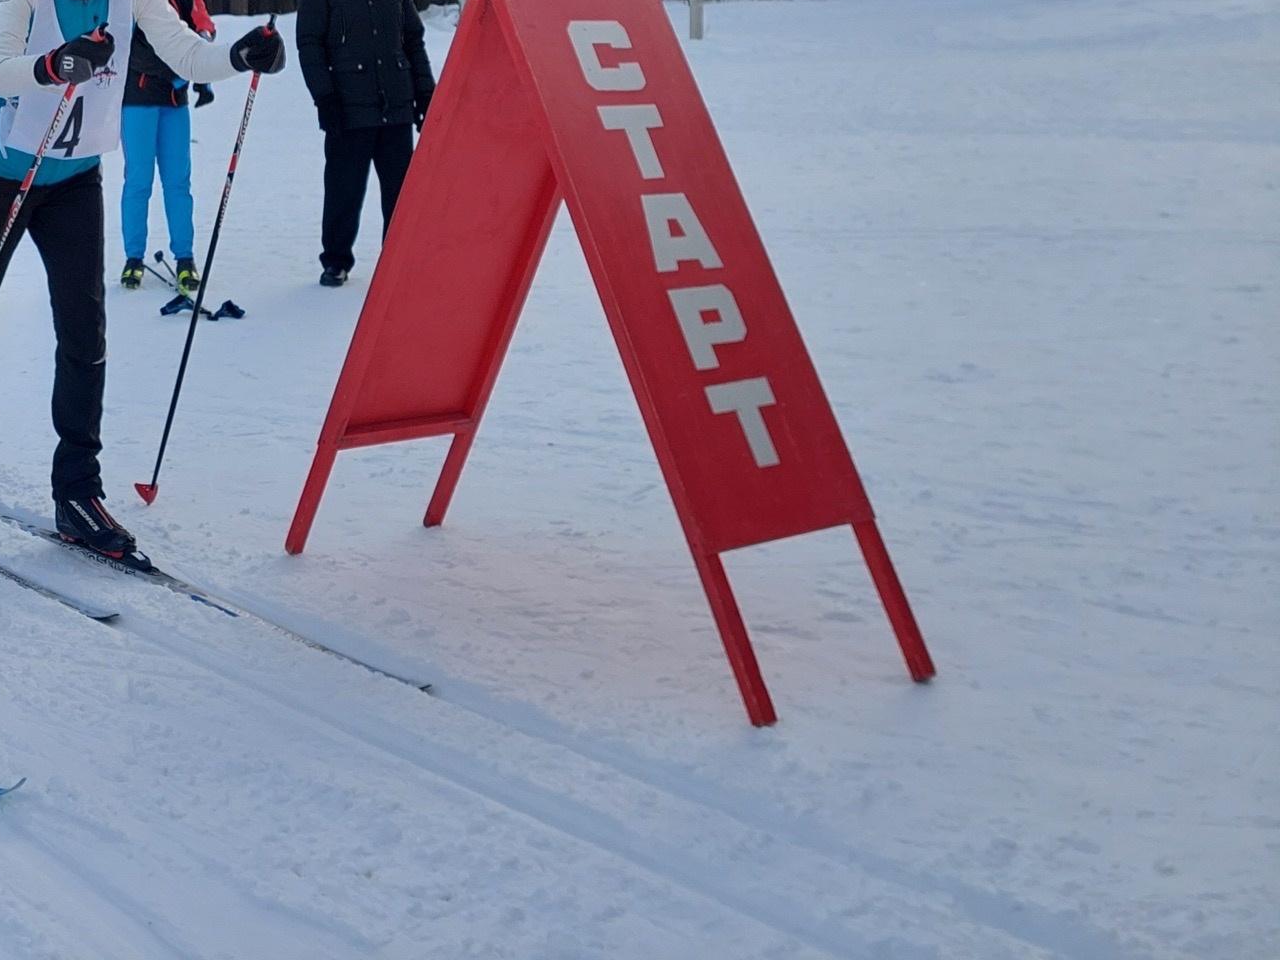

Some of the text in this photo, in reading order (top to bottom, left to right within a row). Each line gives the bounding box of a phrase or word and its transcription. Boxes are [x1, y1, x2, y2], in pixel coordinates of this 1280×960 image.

[52, 95, 85, 158] 4
[567, 20, 781, 467] СТАРТ
[68, 499, 101, 532] ADSHUS
